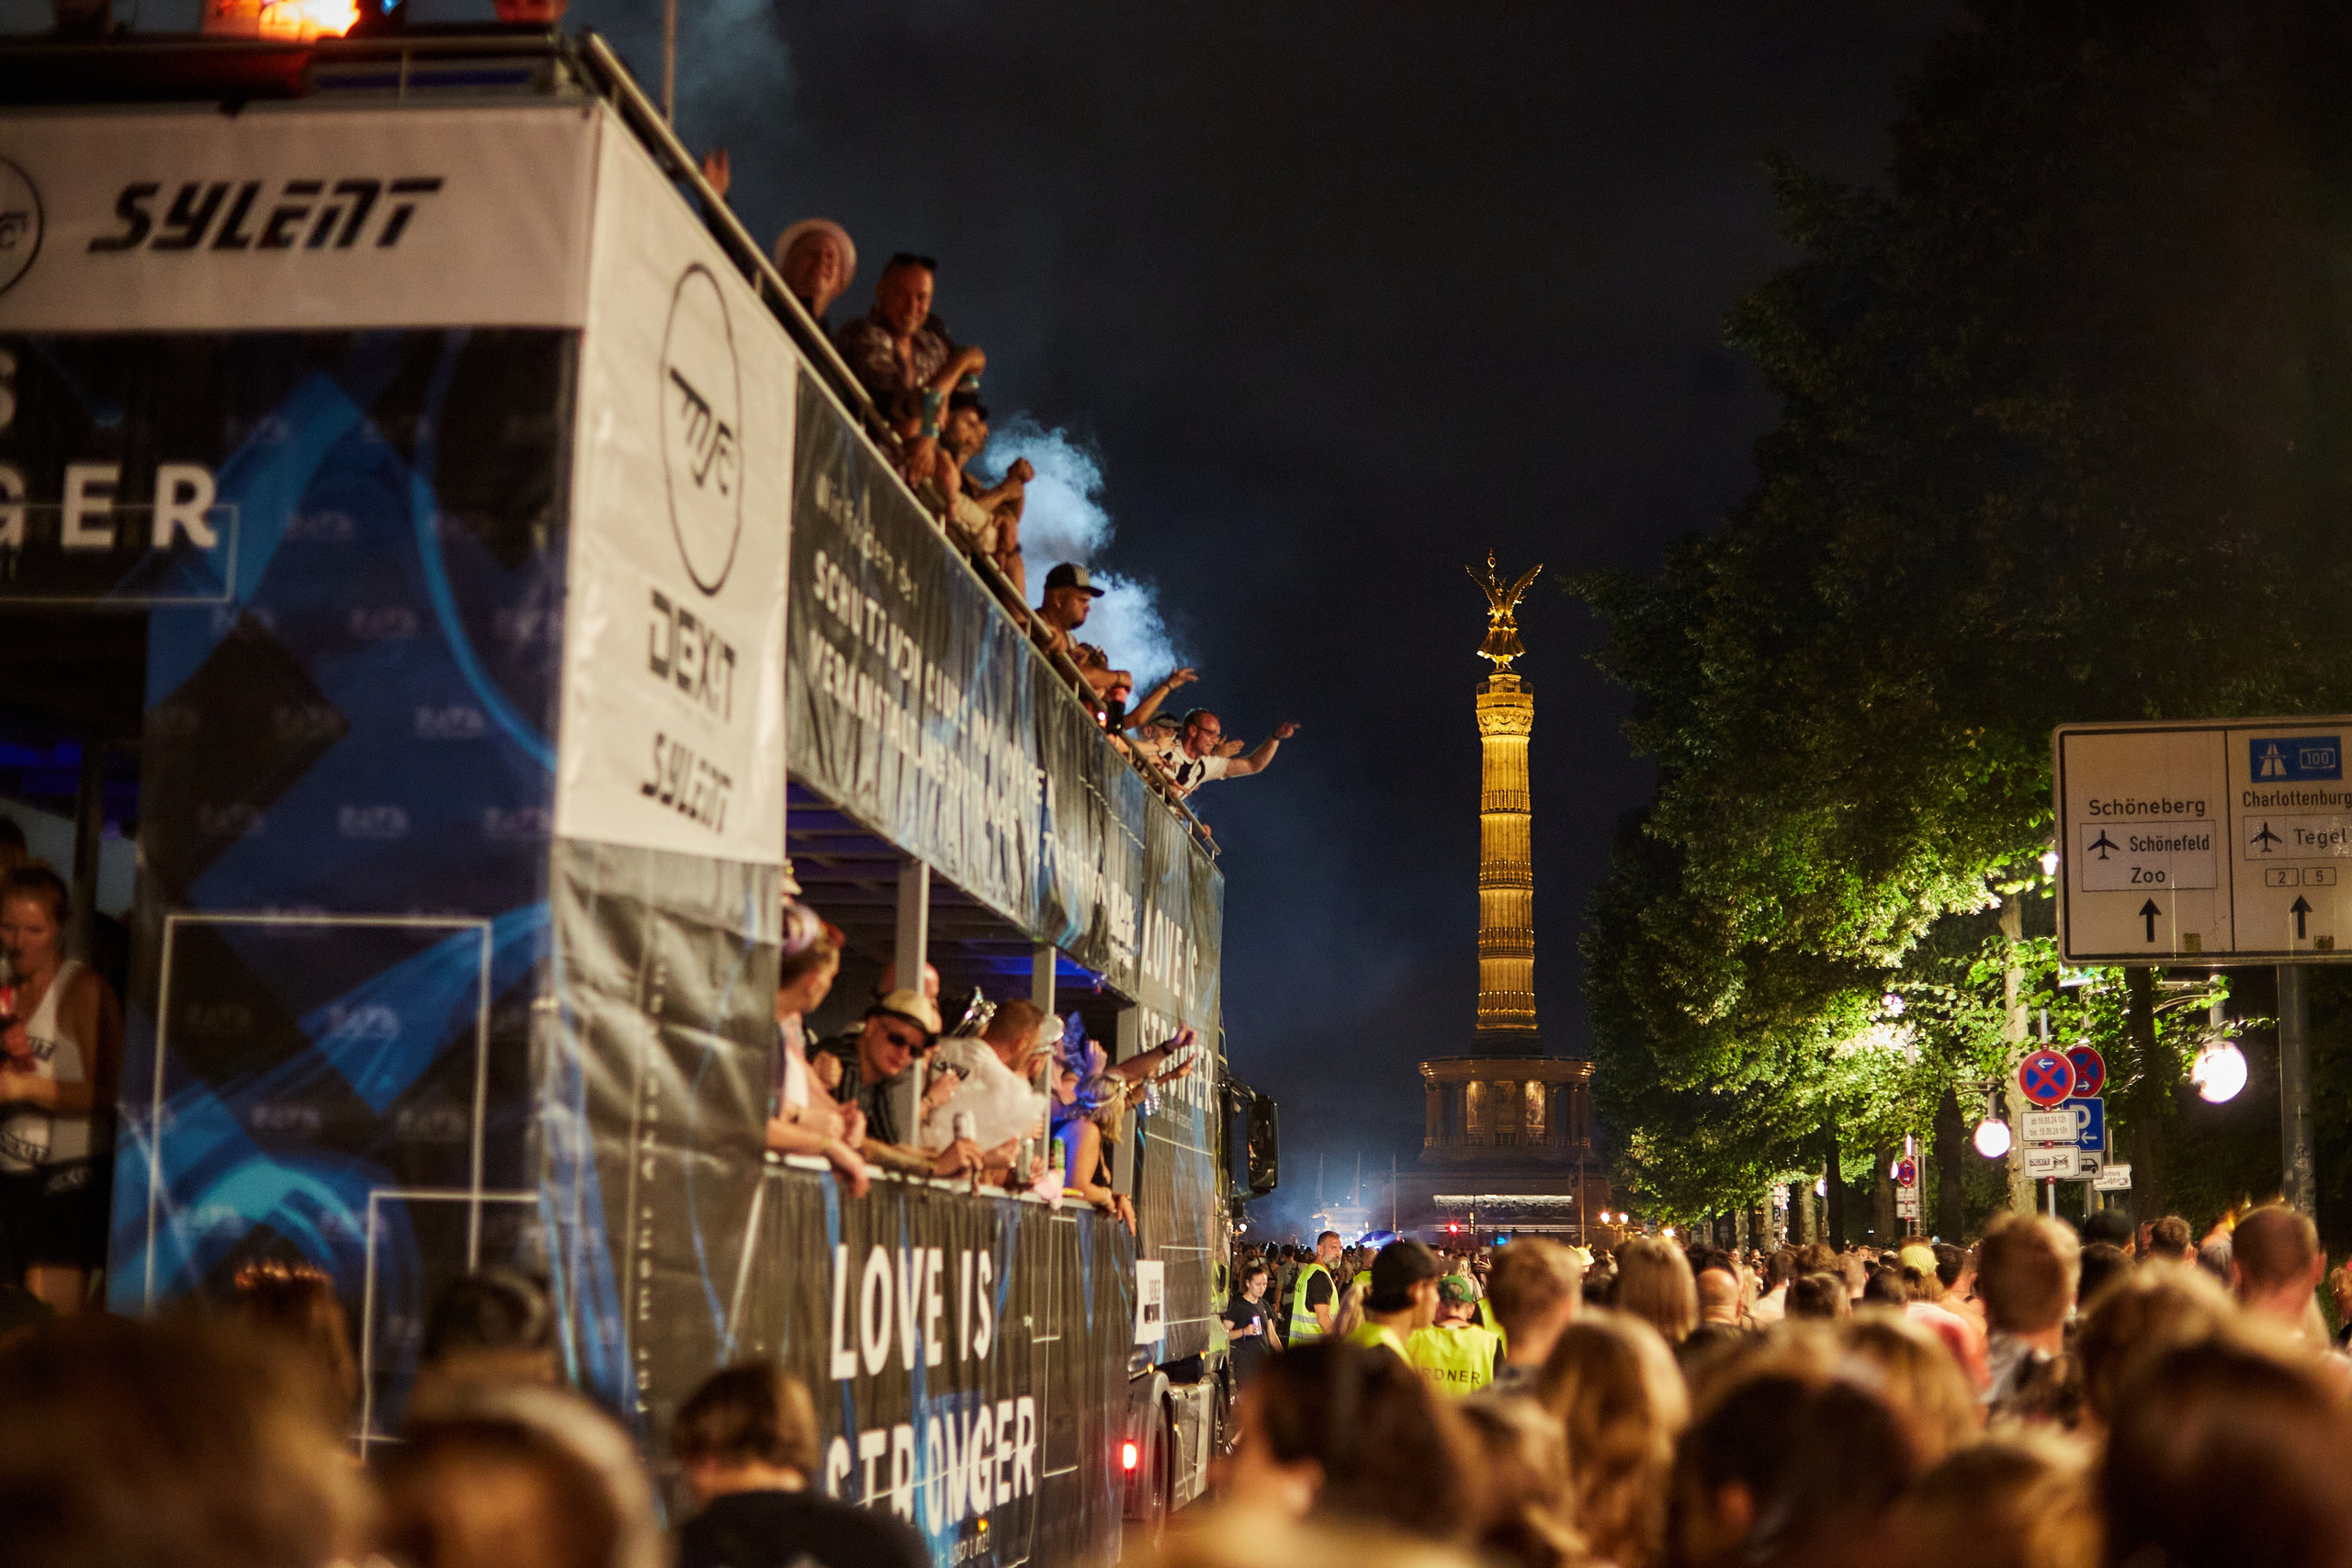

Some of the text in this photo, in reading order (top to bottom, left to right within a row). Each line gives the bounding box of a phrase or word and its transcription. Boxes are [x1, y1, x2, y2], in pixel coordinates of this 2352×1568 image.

[86, 177, 446, 254] SYLENT
[814, 549, 887, 658] SCHUTZ
[2304, 750, 2330, 765] 100
[2088, 797, 2206, 817] Schöneberg
[2243, 788, 2352, 809] Charlottenburg
[2130, 835, 2210, 852] Schönefeld
[2293, 828, 2347, 848] Tegel
[2131, 866, 2165, 884] Zoo
[2278, 870, 2324, 884] 2 5
[1143, 897, 1183, 999] LOVE
[1185, 933, 1199, 1011] IS
[830, 1243, 993, 1381] LOVE IS
[828, 1395, 1036, 1538] STRONGER
